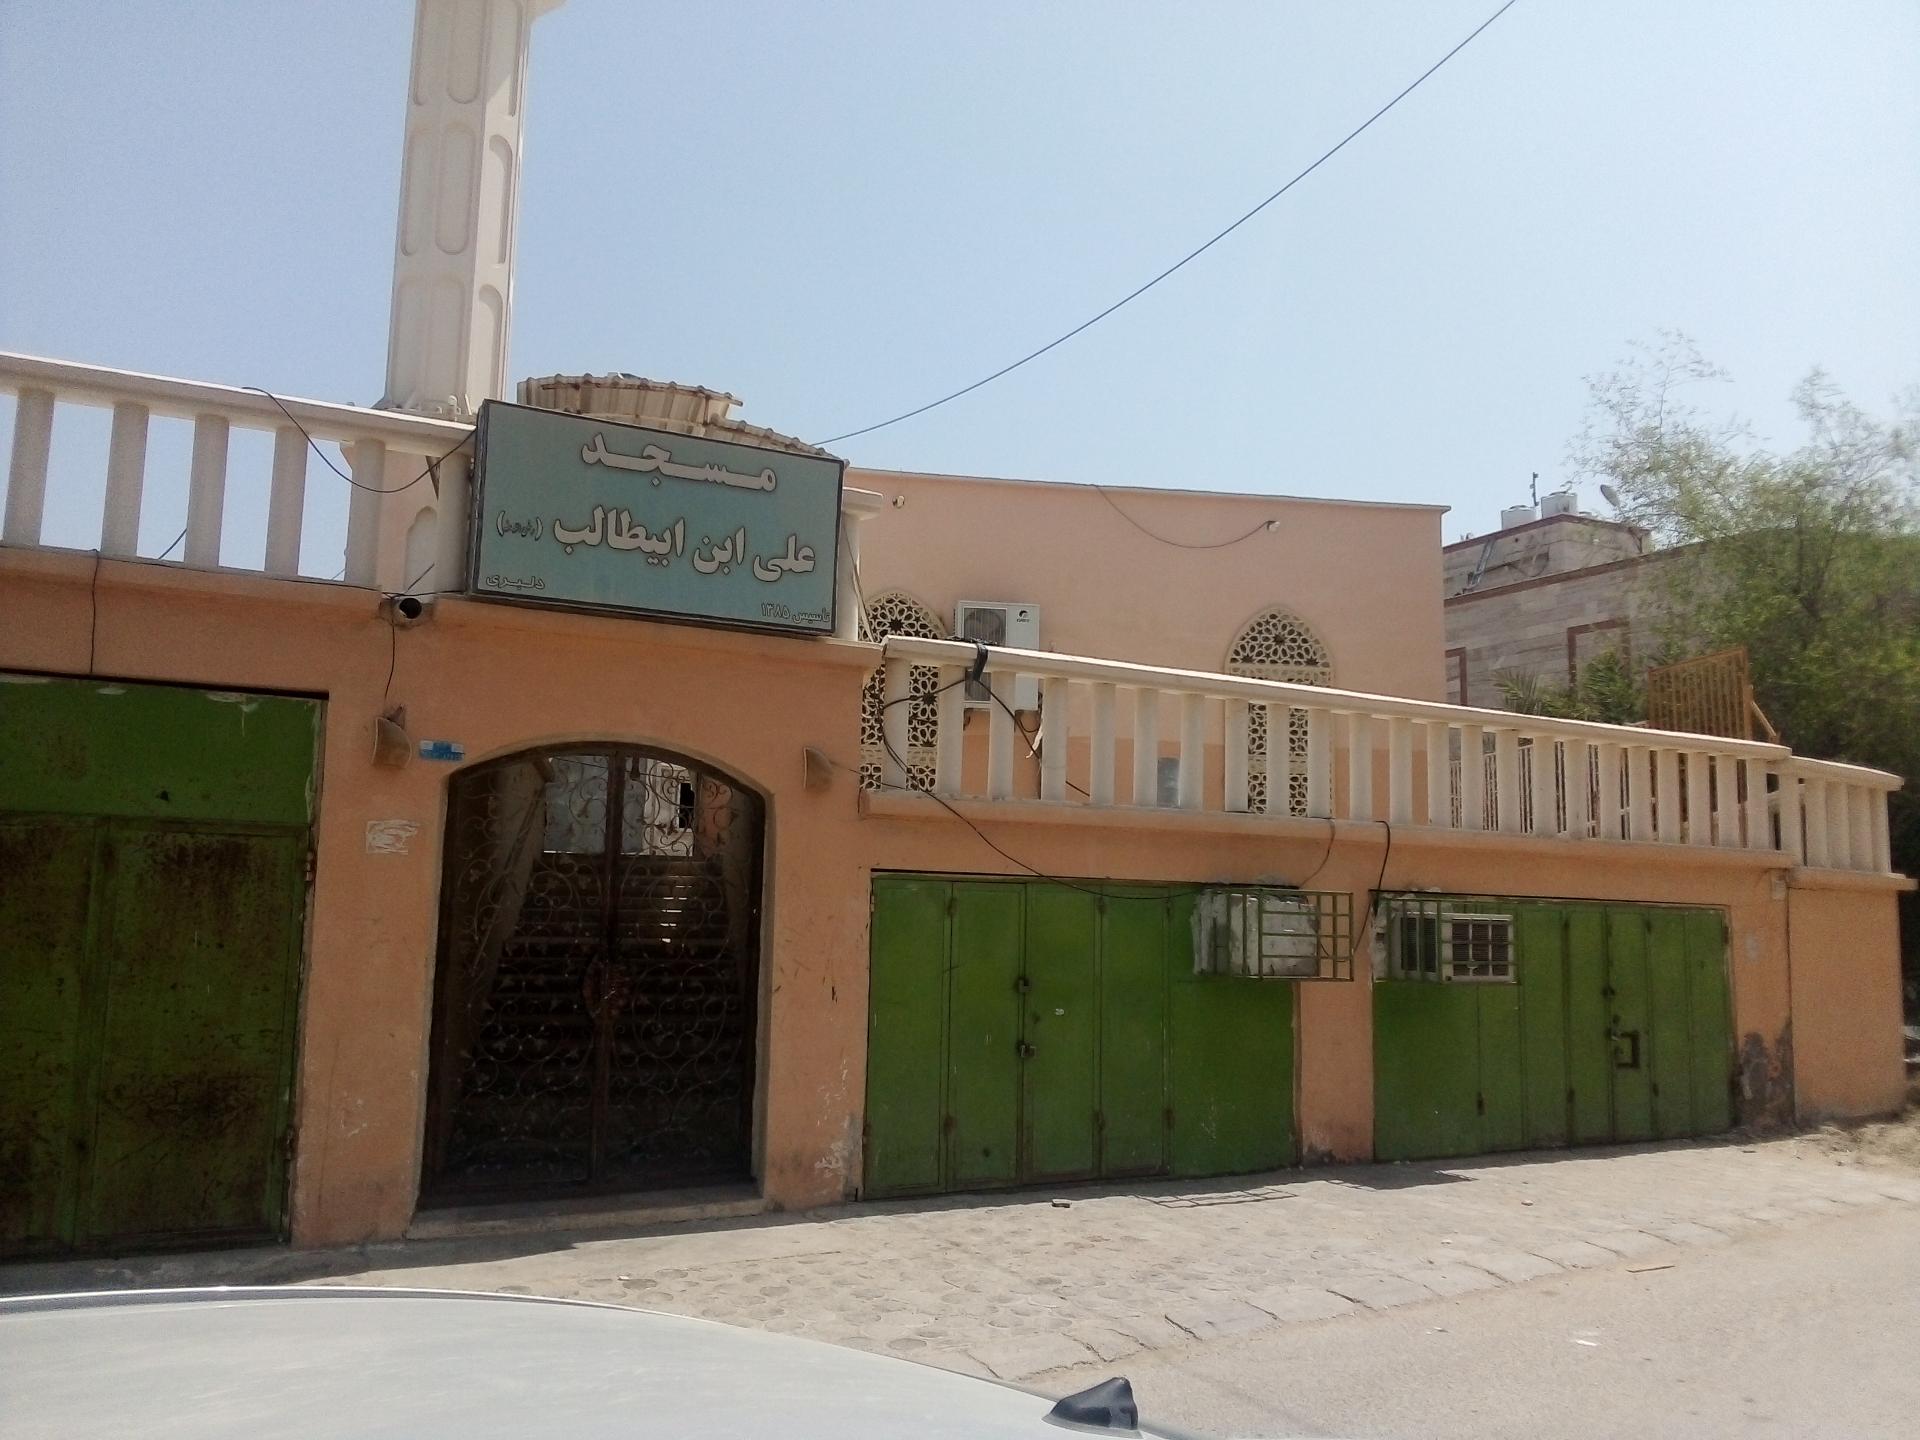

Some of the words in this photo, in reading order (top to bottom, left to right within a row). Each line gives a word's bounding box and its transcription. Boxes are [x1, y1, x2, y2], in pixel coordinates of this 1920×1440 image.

[581, 432, 777, 492] مسجد
[553, 504, 686, 562] ابیطالب
[692, 526, 746, 575] ابن
[752, 533, 816, 582] علی
